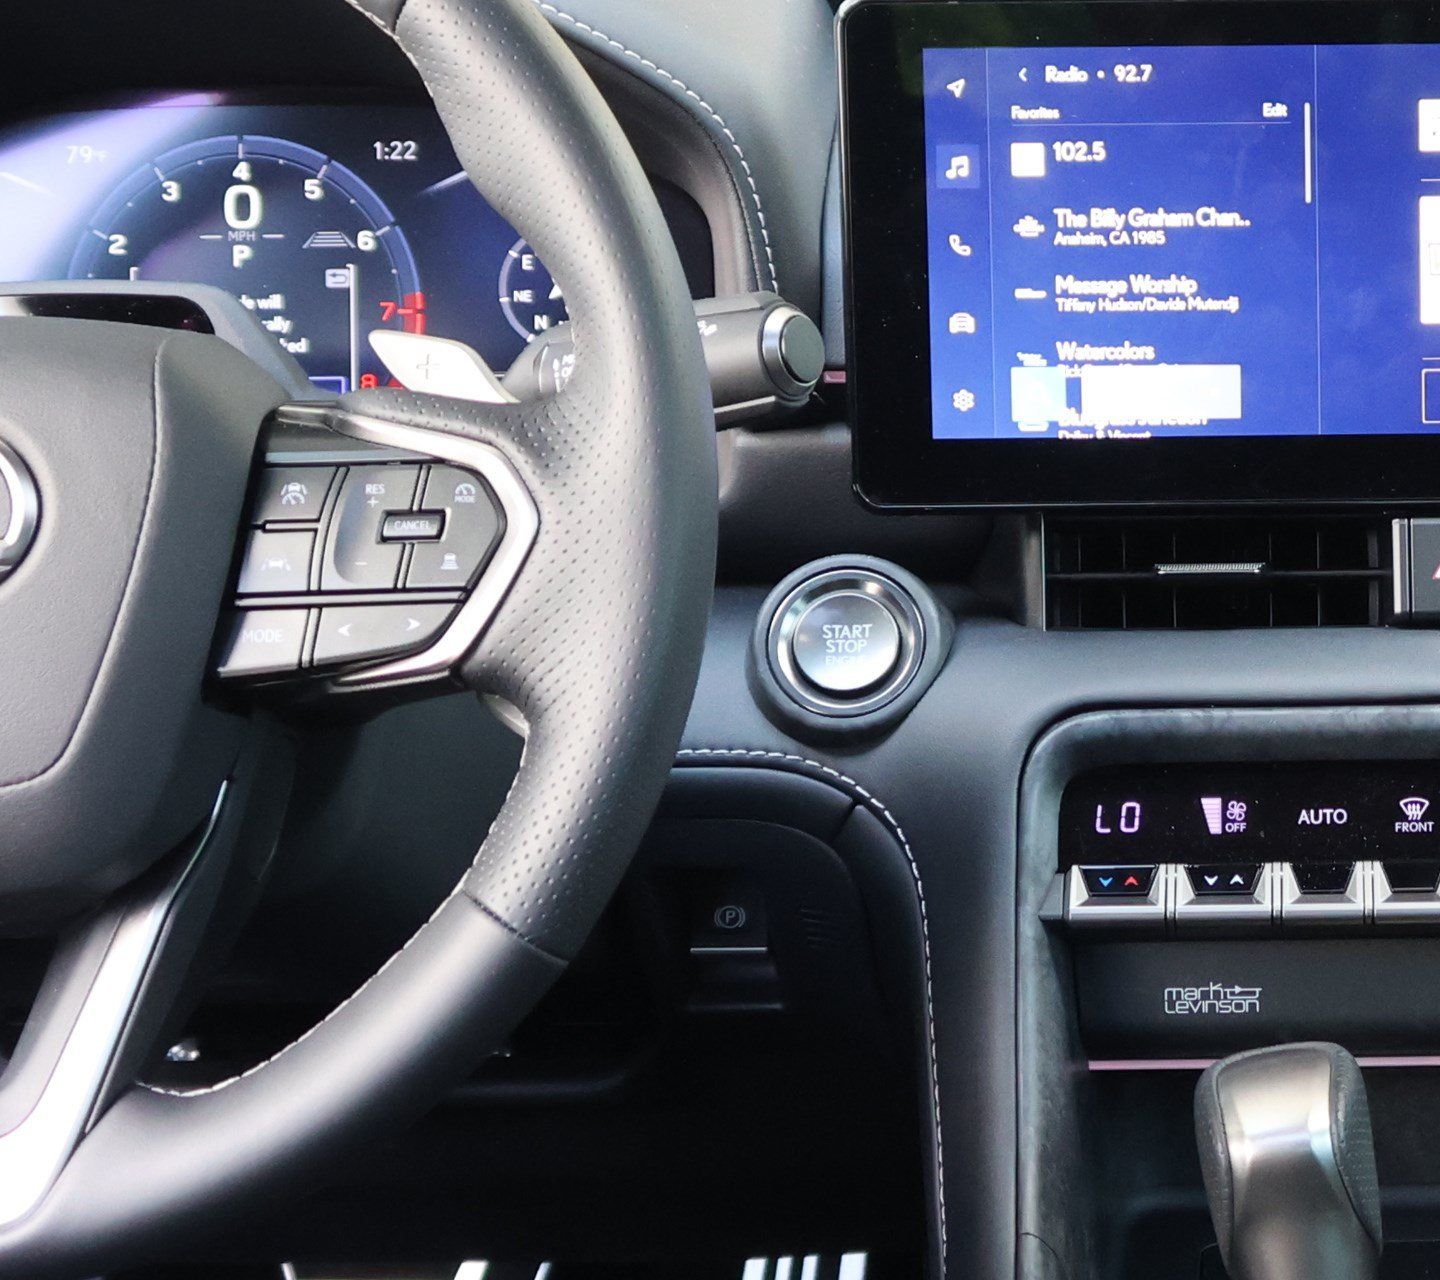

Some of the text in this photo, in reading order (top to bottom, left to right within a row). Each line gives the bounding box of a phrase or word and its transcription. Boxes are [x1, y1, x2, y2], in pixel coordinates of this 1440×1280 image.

[1045, 65, 1152, 82] Radio 92.7
[1263, 102, 1287, 117] Edit
[373, 141, 418, 161] 1:22
[1053, 141, 1106, 161] 102.5
[232, 161, 253, 182] 4
[162, 181, 181, 202] 3
[304, 179, 325, 200] 5
[224, 185, 262, 230] 0
[1053, 207, 1087, 228] The
[1090, 207, 1126, 230] Billy
[1128, 207, 1194, 228] Graham
[228, 230, 256, 242] MPH
[357, 230, 377, 251] 6
[1109, 231, 1130, 245] CA
[108, 235, 129, 255] 2
[232, 245, 254, 268] P
[521, 254, 535, 271] E
[1055, 273, 1198, 298] Message Worship
[513, 289, 534, 303] NE
[379, 301, 398, 321] 7
[534, 314, 549, 329] N
[1055, 341, 1156, 361] Watercolors
[365, 483, 386, 496] RES
[394, 519, 431, 531] CANCEL
[242, 627, 284, 644] MODE
[822, 623, 873, 639] START
[826, 639, 868, 653] STOP
[1298, 808, 1348, 825] AUTO
[1225, 822, 1247, 833] OFF
[1395, 821, 1435, 833] FRONT
[1164, 982, 1224, 1000] mark
